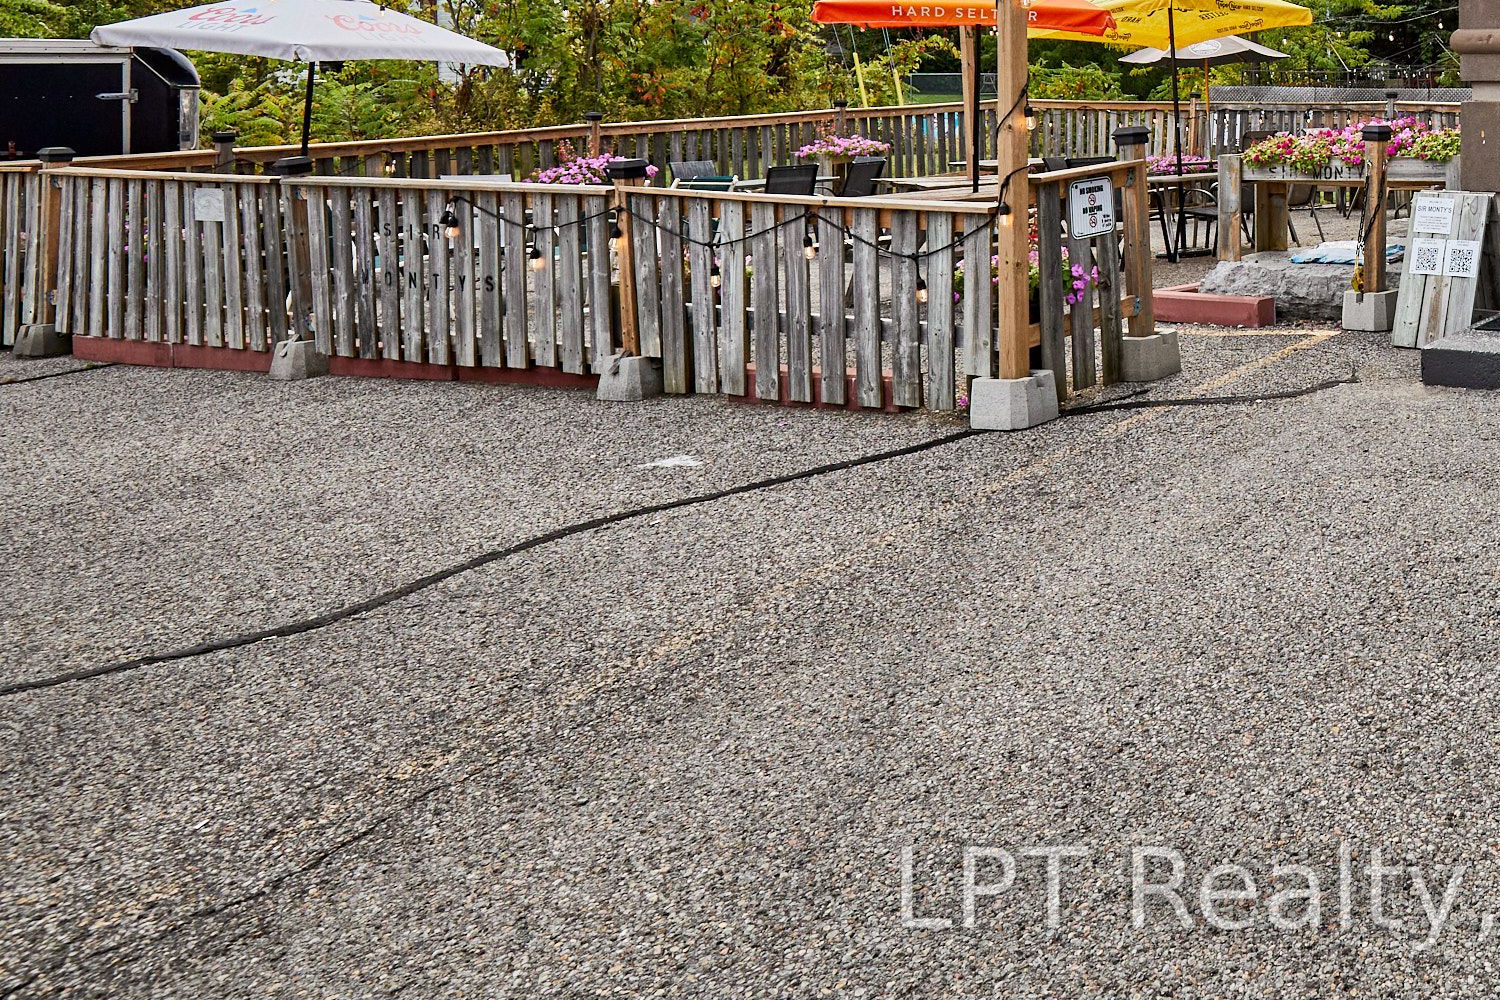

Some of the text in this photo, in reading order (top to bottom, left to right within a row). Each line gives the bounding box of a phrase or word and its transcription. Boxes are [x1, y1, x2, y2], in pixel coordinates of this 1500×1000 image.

[189, 7, 277, 25] Coors
[892, 5, 1038, 21] HARD SELTR
[177, 20, 244, 32] LIGHT
[325, 13, 424, 35] Coors
[1428, 206, 1452, 214] MONTY'S
[383, 222, 441, 241] SIR
